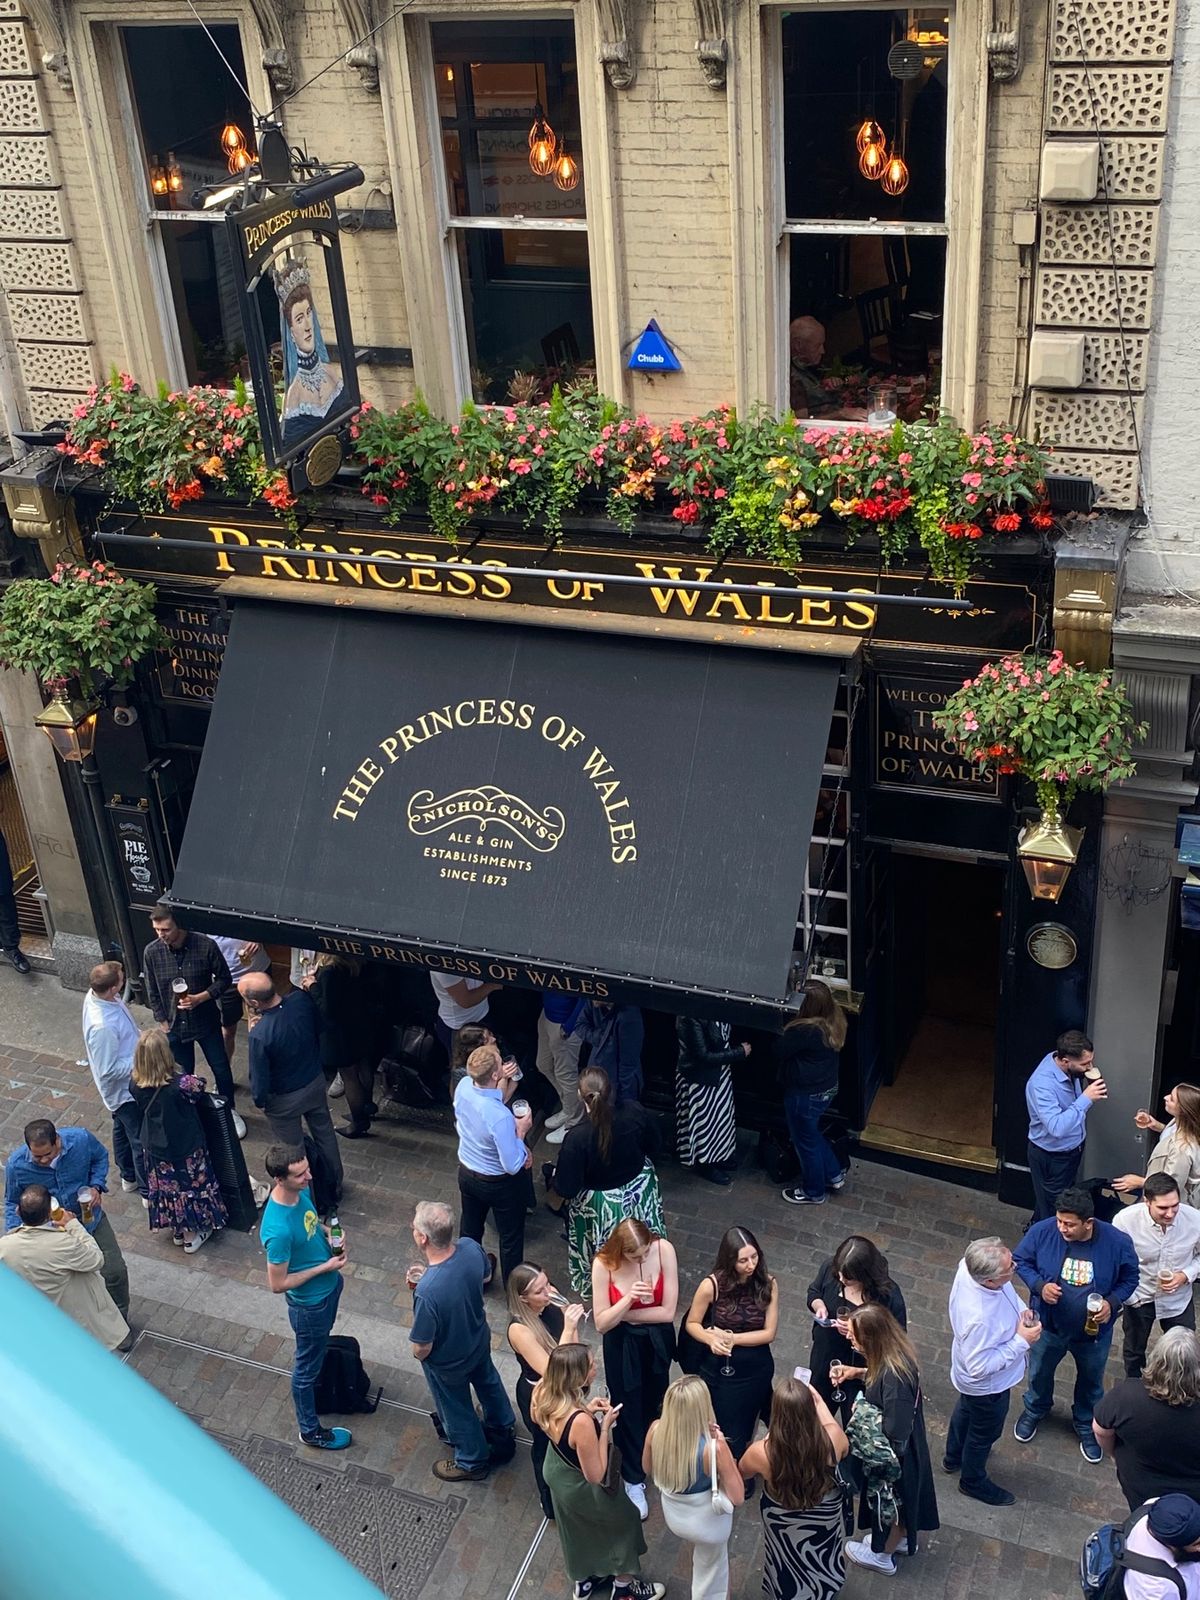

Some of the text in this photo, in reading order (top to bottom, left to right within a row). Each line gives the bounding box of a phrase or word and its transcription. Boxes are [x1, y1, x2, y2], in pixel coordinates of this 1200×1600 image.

[244, 210, 292, 259] PRINCESS
[300, 199, 332, 219] WALES
[637, 353, 665, 363] Chubb
[208, 526, 876, 630] PRINCESS OF WALES
[175, 608, 210, 627] THE
[172, 663, 220, 681] DININ
[181, 681, 216, 698] ROO
[885, 688, 951, 704] WELCO
[884, 731, 967, 756] PRINCE
[881, 757, 994, 783] OF WALES
[332, 698, 639, 865] THE PRINCESS OF WALES
[421, 800, 549, 839] NICHOLSON'S
[124, 840, 147, 854] PIE
[448, 832, 514, 850] ALE & GIN
[423, 847, 533, 872] ESTABLISHMENTS
[439, 867, 508, 887] SINCE 1873
[318, 936, 609, 997] THE PRINCESS OF WALES
